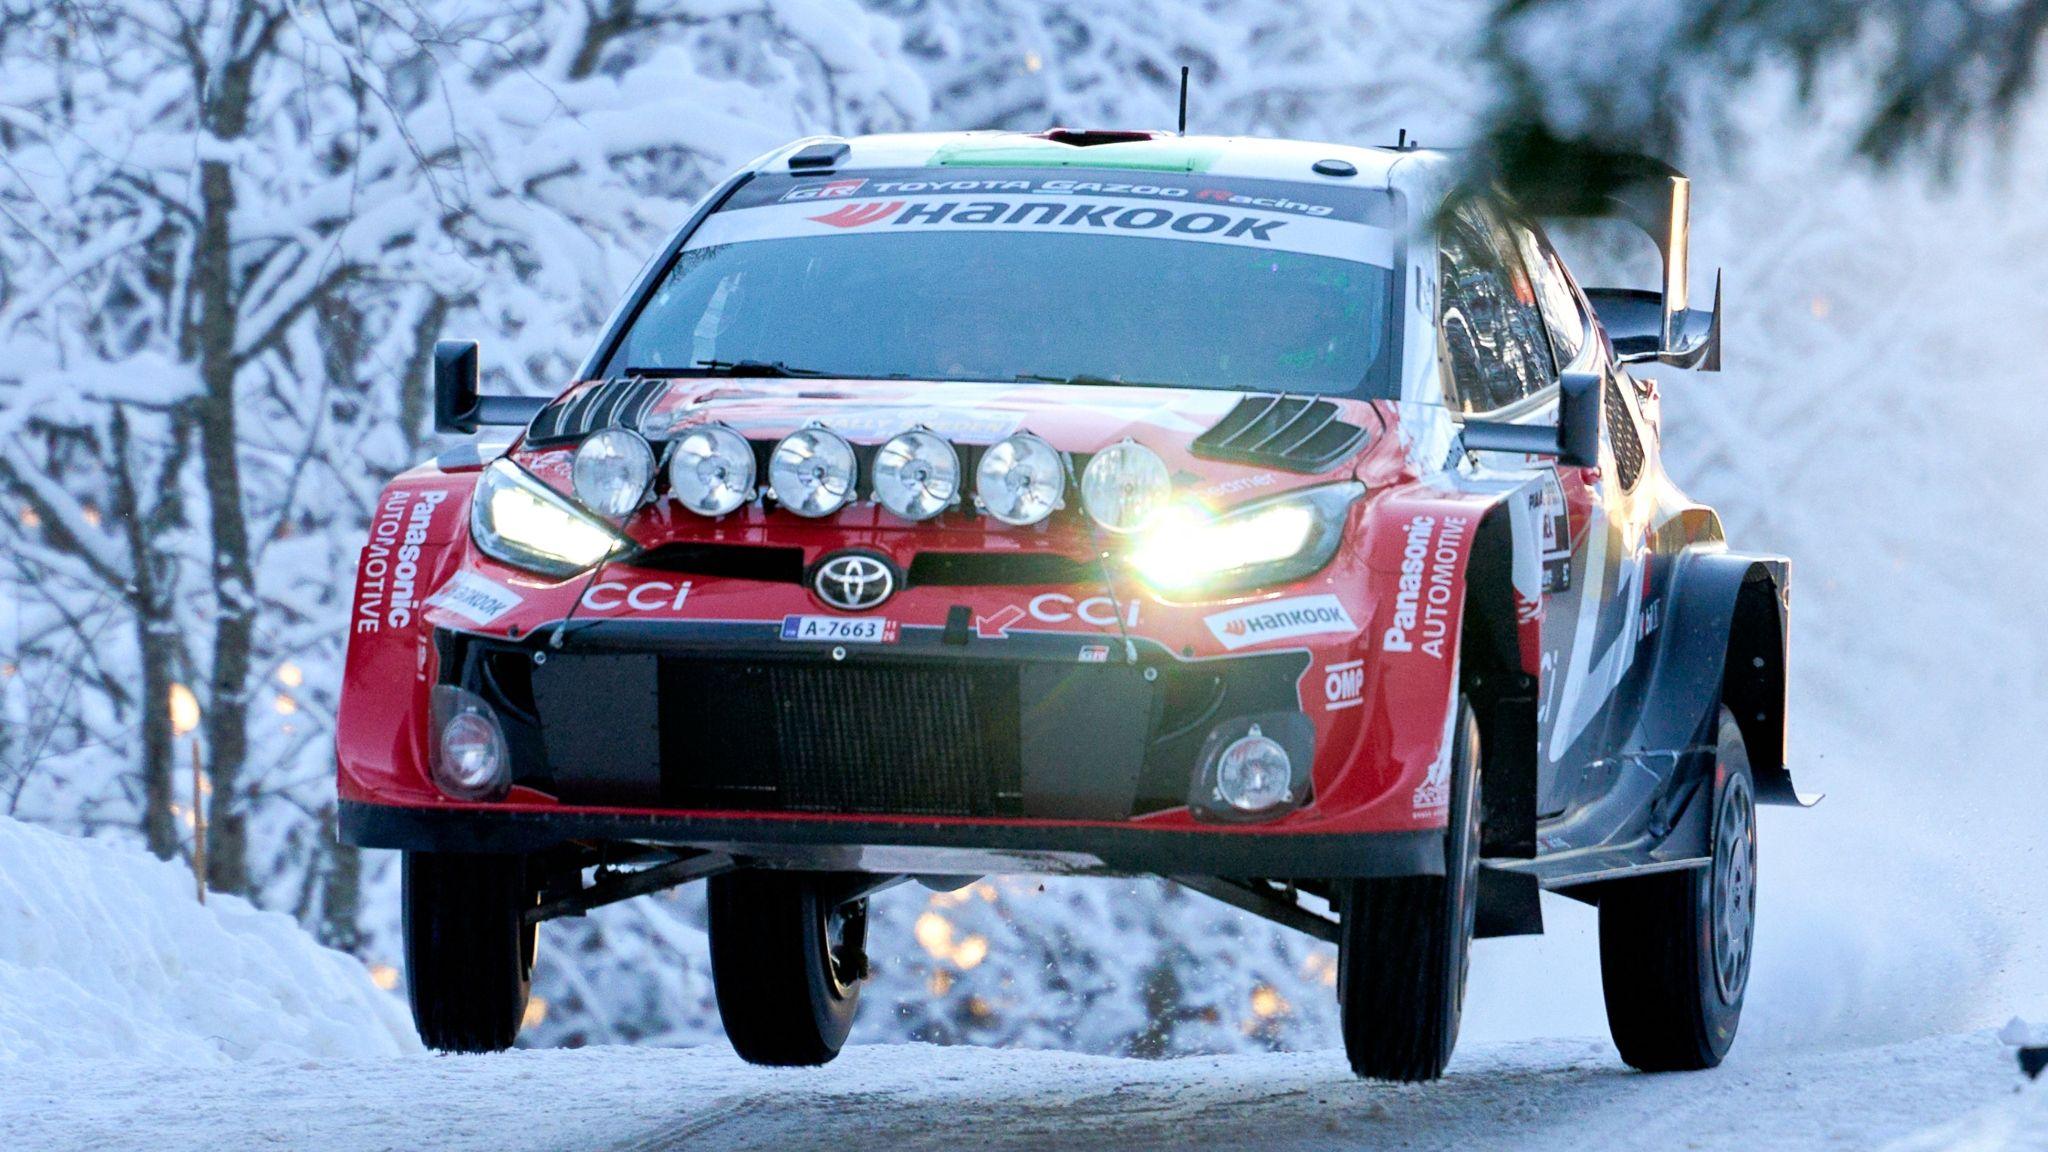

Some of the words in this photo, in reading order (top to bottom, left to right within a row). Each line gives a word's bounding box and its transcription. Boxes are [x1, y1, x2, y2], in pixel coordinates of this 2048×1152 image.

[784, 182, 859, 200] GR
[872, 180, 1031, 193] TOYOTA
[1041, 180, 1189, 197] GAZOO
[1196, 188, 1334, 216] Racing
[357, 490, 411, 634] AUTOMOTIVE
[388, 490, 448, 629] Panasonic
[1382, 515, 1436, 653] Panasonic
[1421, 515, 1468, 660] AUTOMOTIVE
[805, 620, 877, 638] A-7663
[1325, 667, 1365, 702] OMP
